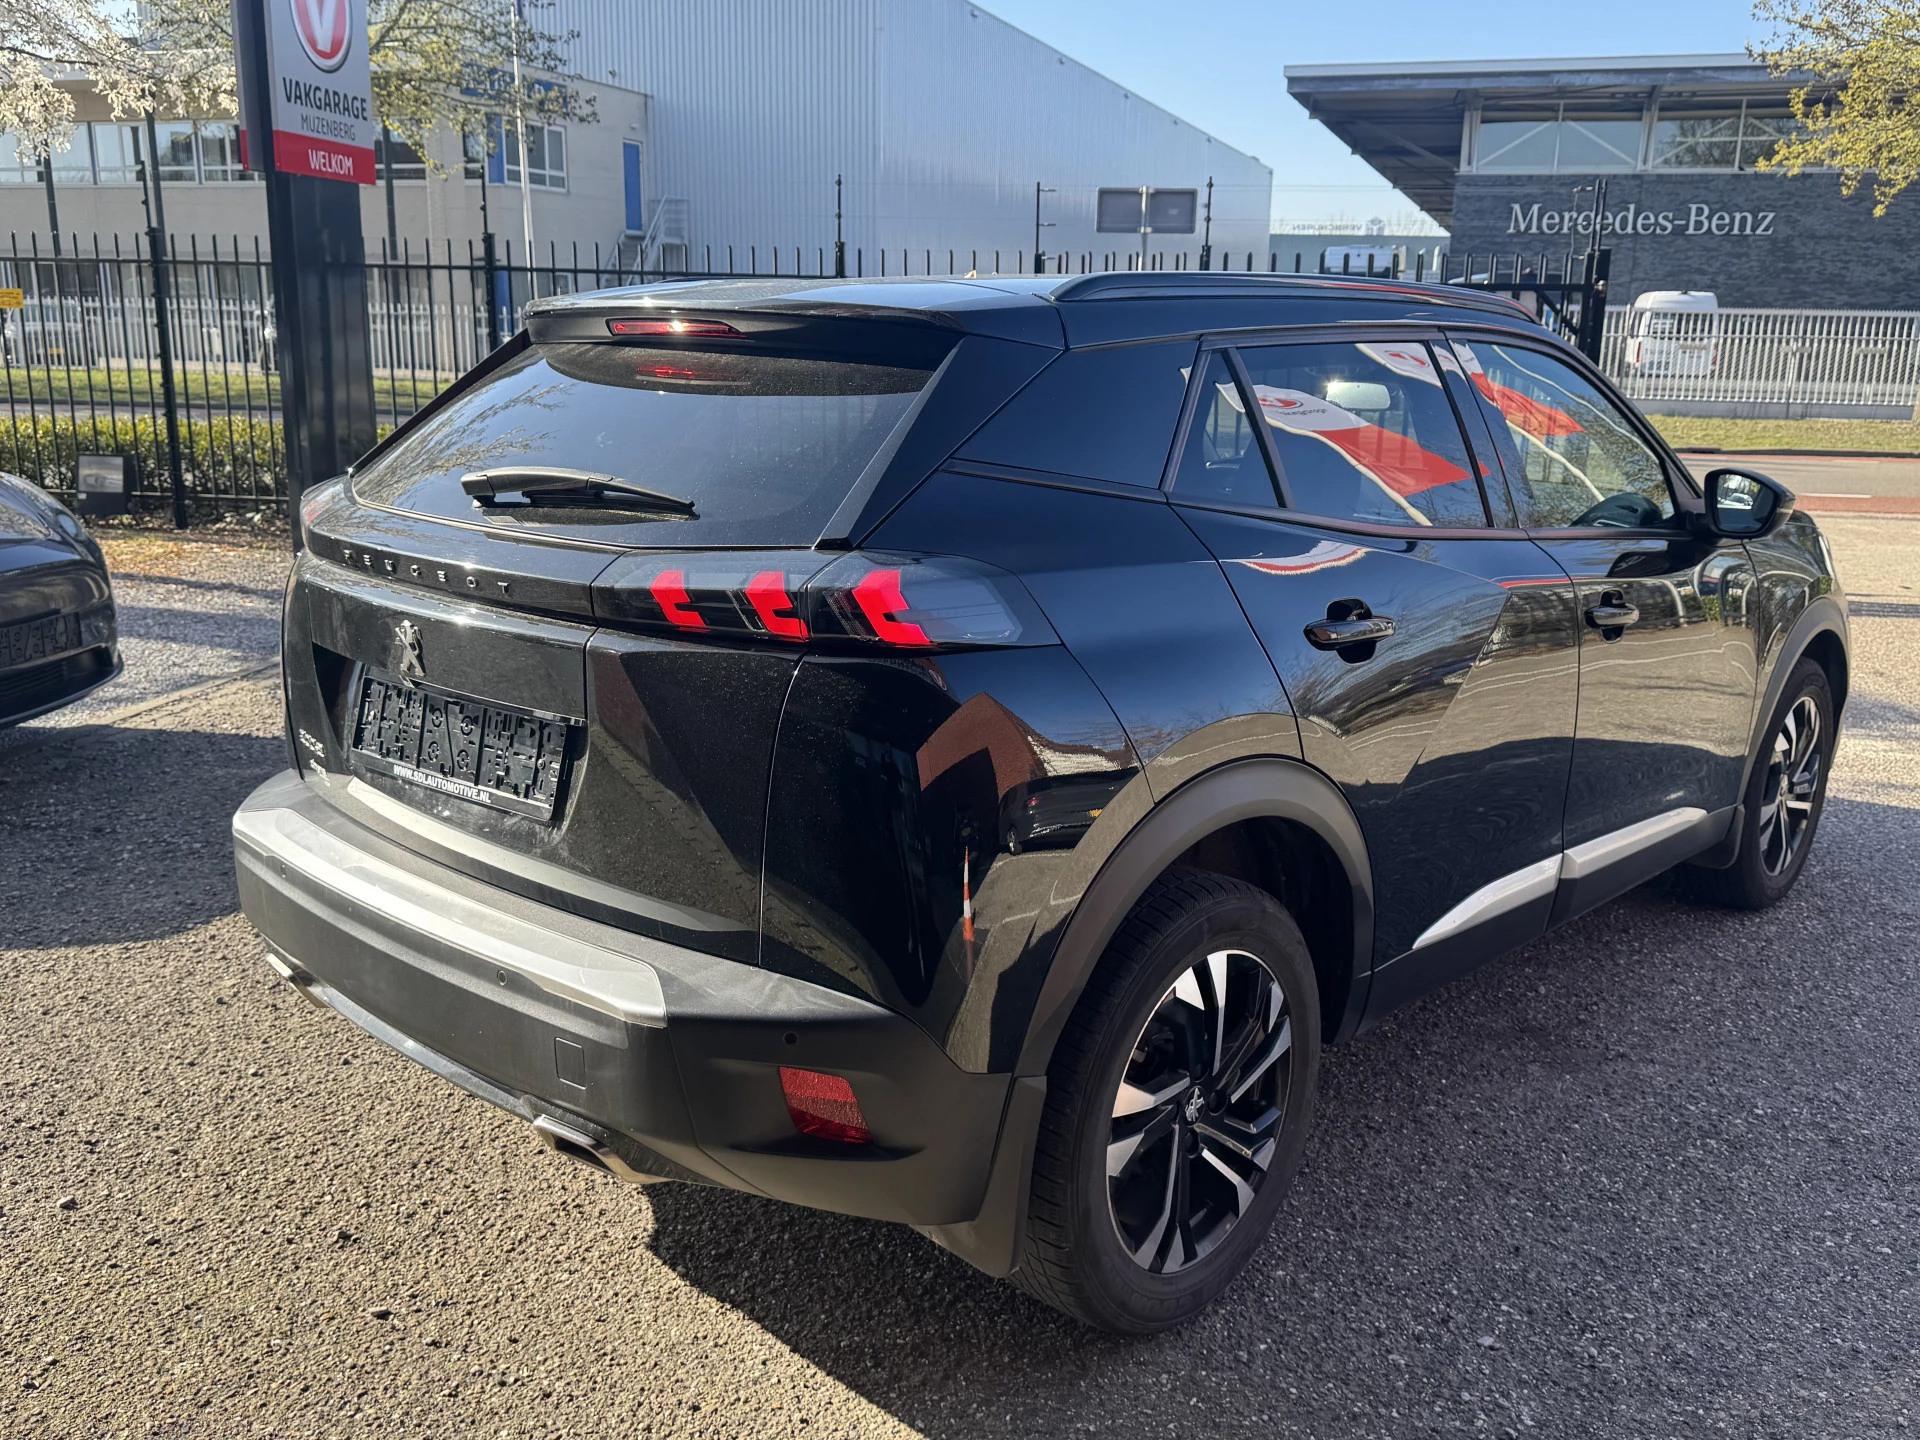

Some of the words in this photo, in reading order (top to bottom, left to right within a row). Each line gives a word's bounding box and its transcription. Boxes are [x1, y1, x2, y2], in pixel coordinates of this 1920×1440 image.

[282, 76, 368, 122] VAKGARAGE
[301, 113, 356, 141] MUZENBERG
[308, 149, 354, 176] WELKOM
[1506, 203, 1776, 235] Mercedes-Benz
[344, 549, 509, 593] PEUGEOT
[393, 764, 491, 804] WWW.SDLAUTOMOTIVE.NL
